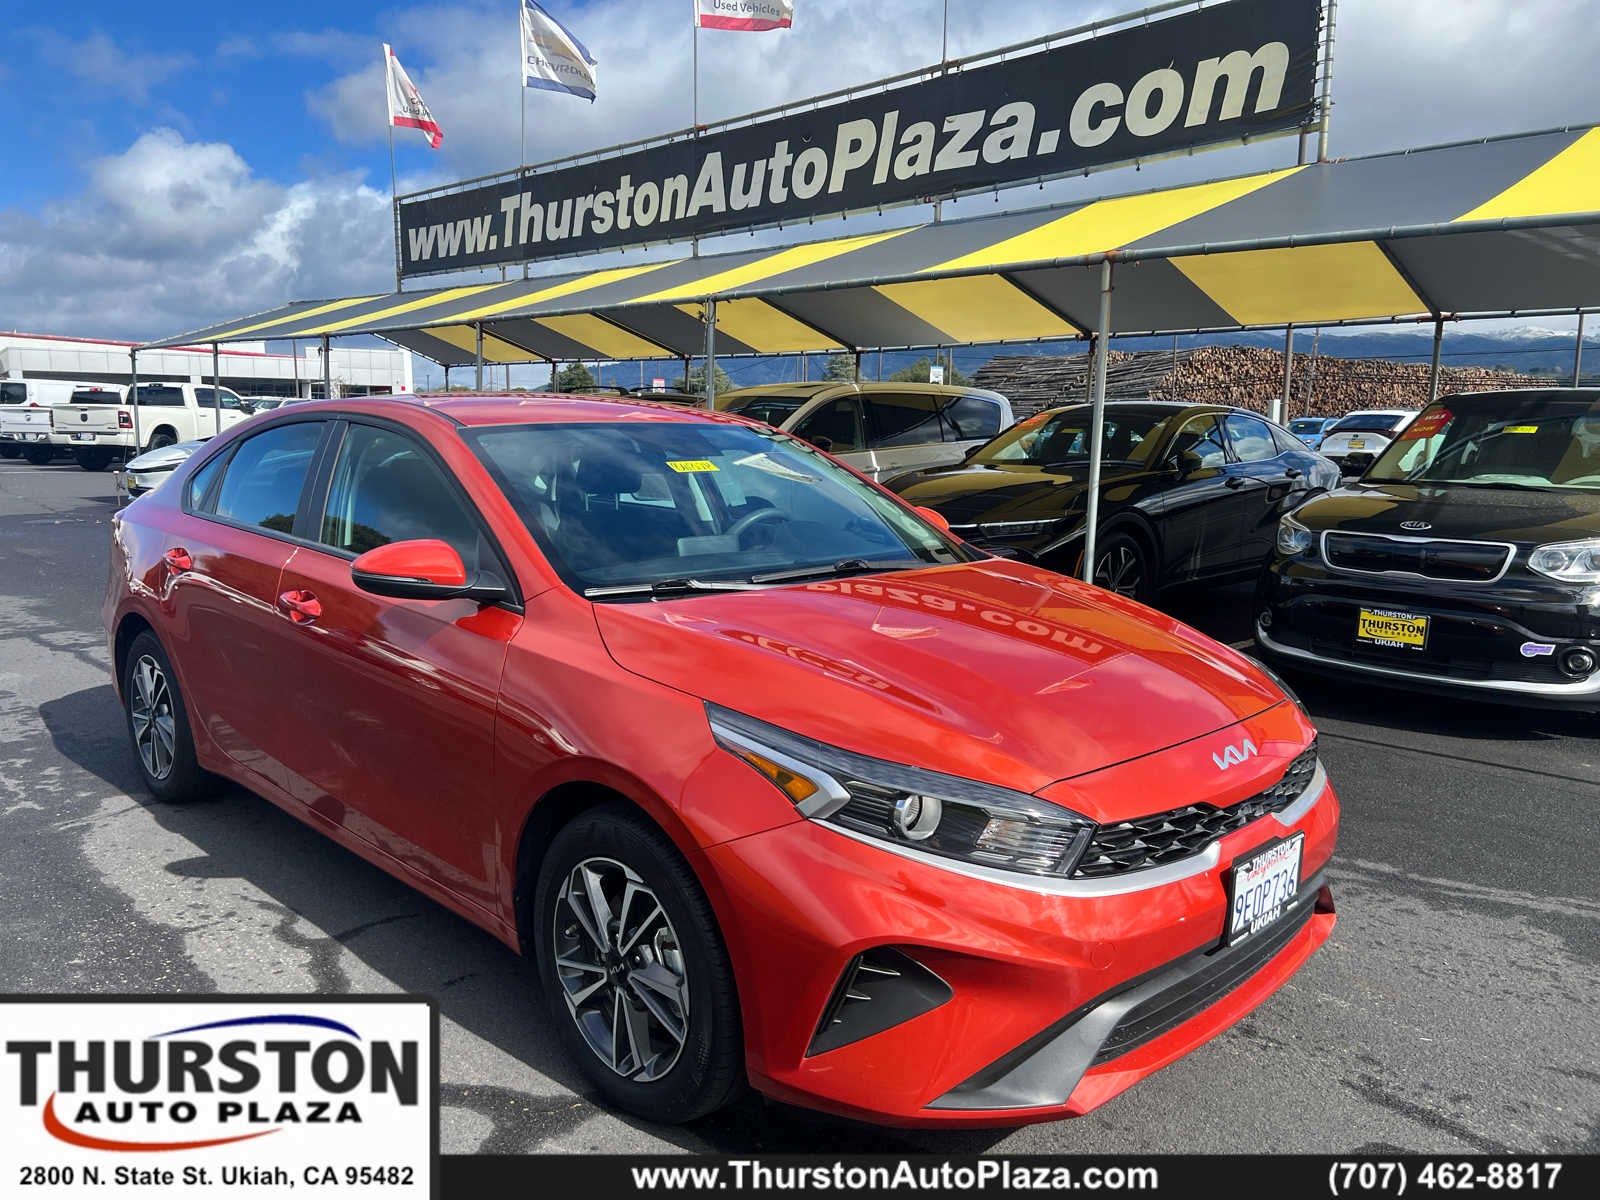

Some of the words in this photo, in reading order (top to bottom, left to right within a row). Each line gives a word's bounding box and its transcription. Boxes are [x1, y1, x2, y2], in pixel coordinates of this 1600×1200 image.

[713, 0, 738, 11] Used
[740, 2, 780, 17] Vehicles
[408, 41, 1290, 262] www.ThurstonAutoPlaza.com
[1373, 609, 1413, 620] THURSTON
[1360, 618, 1425, 637] THURSTON
[1374, 638, 1404, 648] UKIAH
[1212, 738, 1258, 771] KIA
[1251, 839, 1292, 872] THURSTON
[1250, 905, 1281, 934] UKIAH
